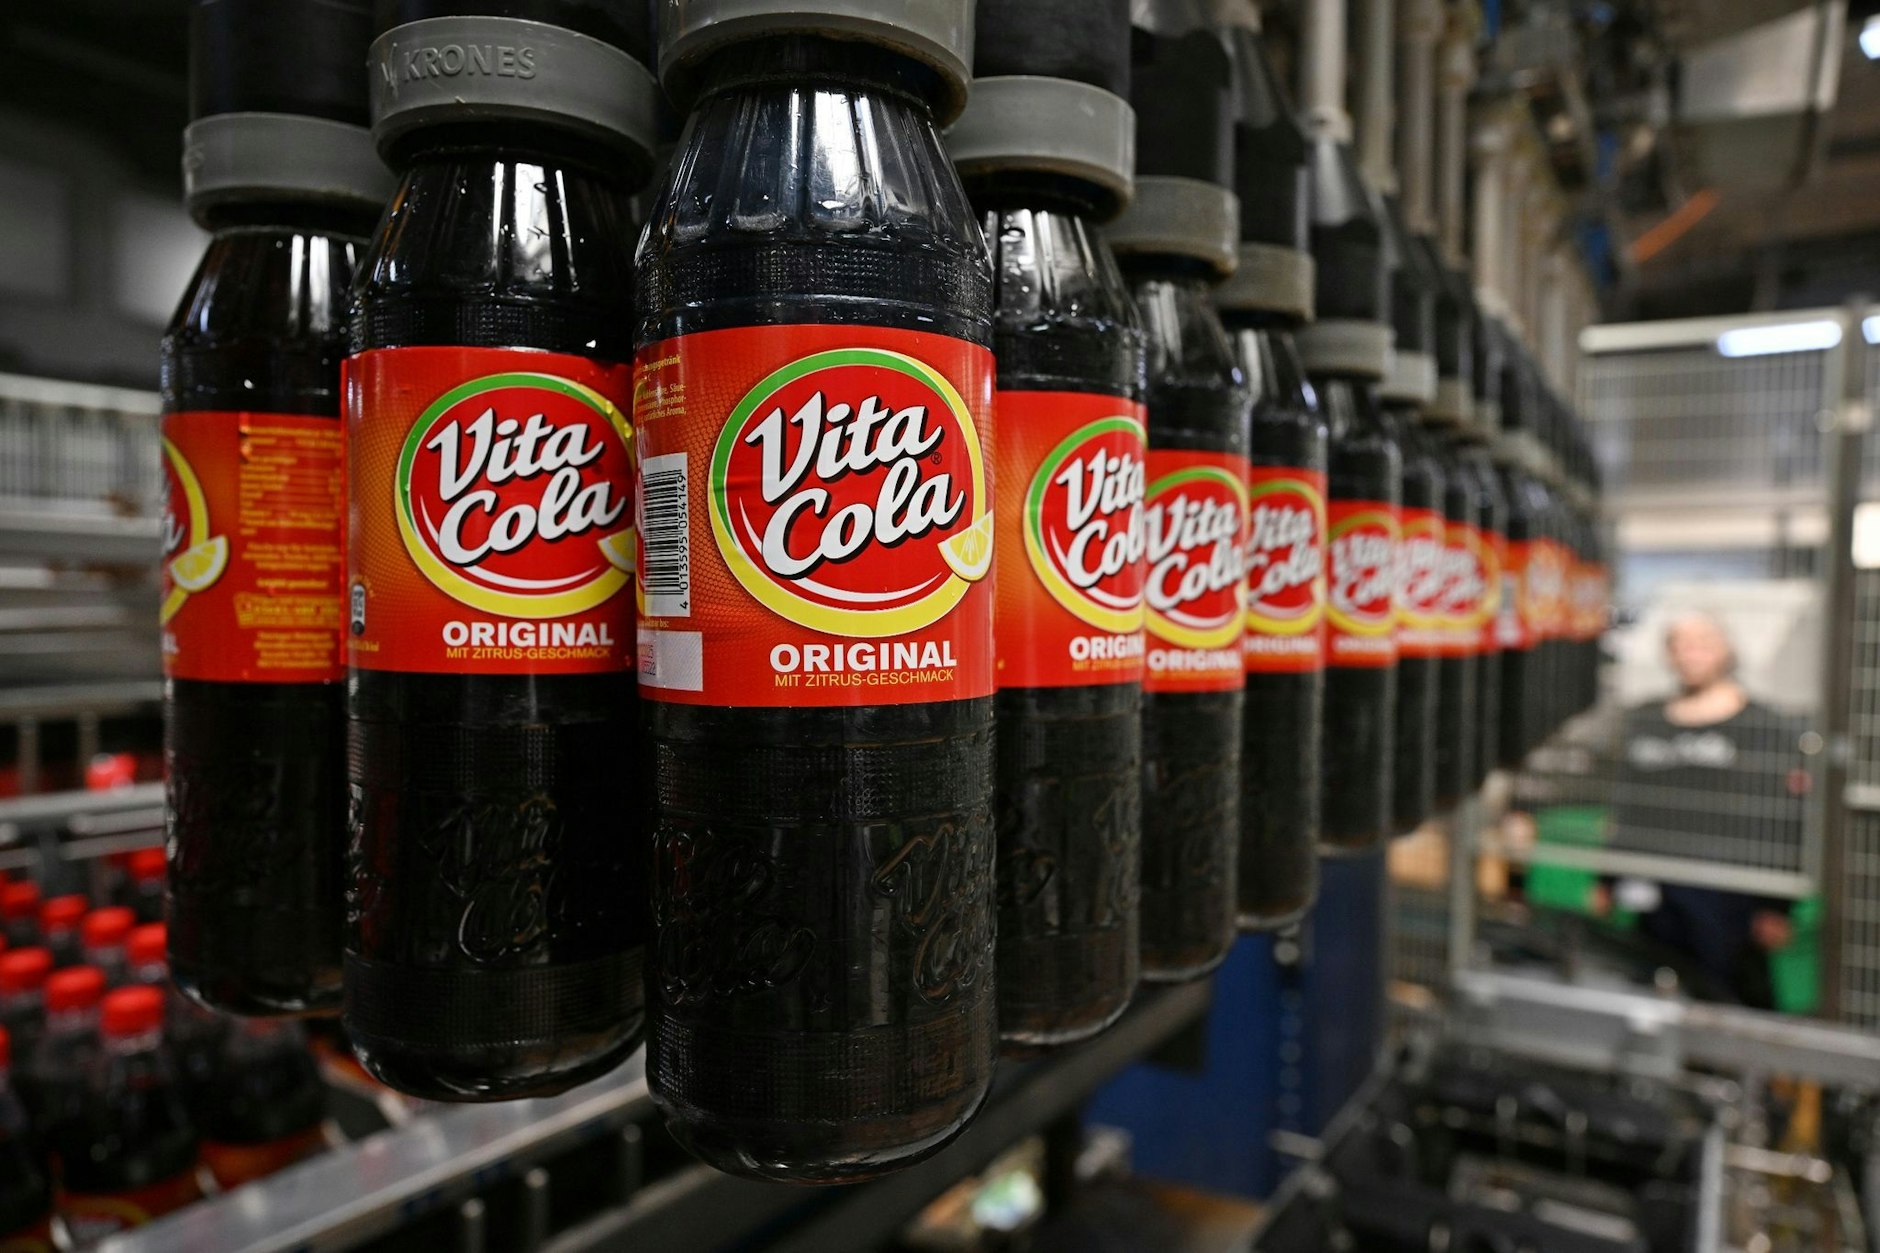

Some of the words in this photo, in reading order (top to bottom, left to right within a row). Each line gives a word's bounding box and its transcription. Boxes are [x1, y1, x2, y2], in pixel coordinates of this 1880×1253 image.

[403, 43, 537, 82] KRONES
[426, 407, 605, 502] Vita
[745, 390, 943, 505] Vita
[439, 466, 626, 566] Cola
[677, 475, 688, 529] 054149
[762, 457, 966, 578] Cola
[678, 536, 689, 590] 013595
[1065, 499, 1145, 589] Col
[442, 620, 615, 647] ORIGINAL
[446, 647, 470, 659] MIT
[472, 646, 611, 660] ZITRUS-GESCHMACK
[769, 640, 958, 673] ORIGINAL
[774, 673, 803, 687] MIT
[805, 669, 954, 687] ZITRUS-GESCHMACK
